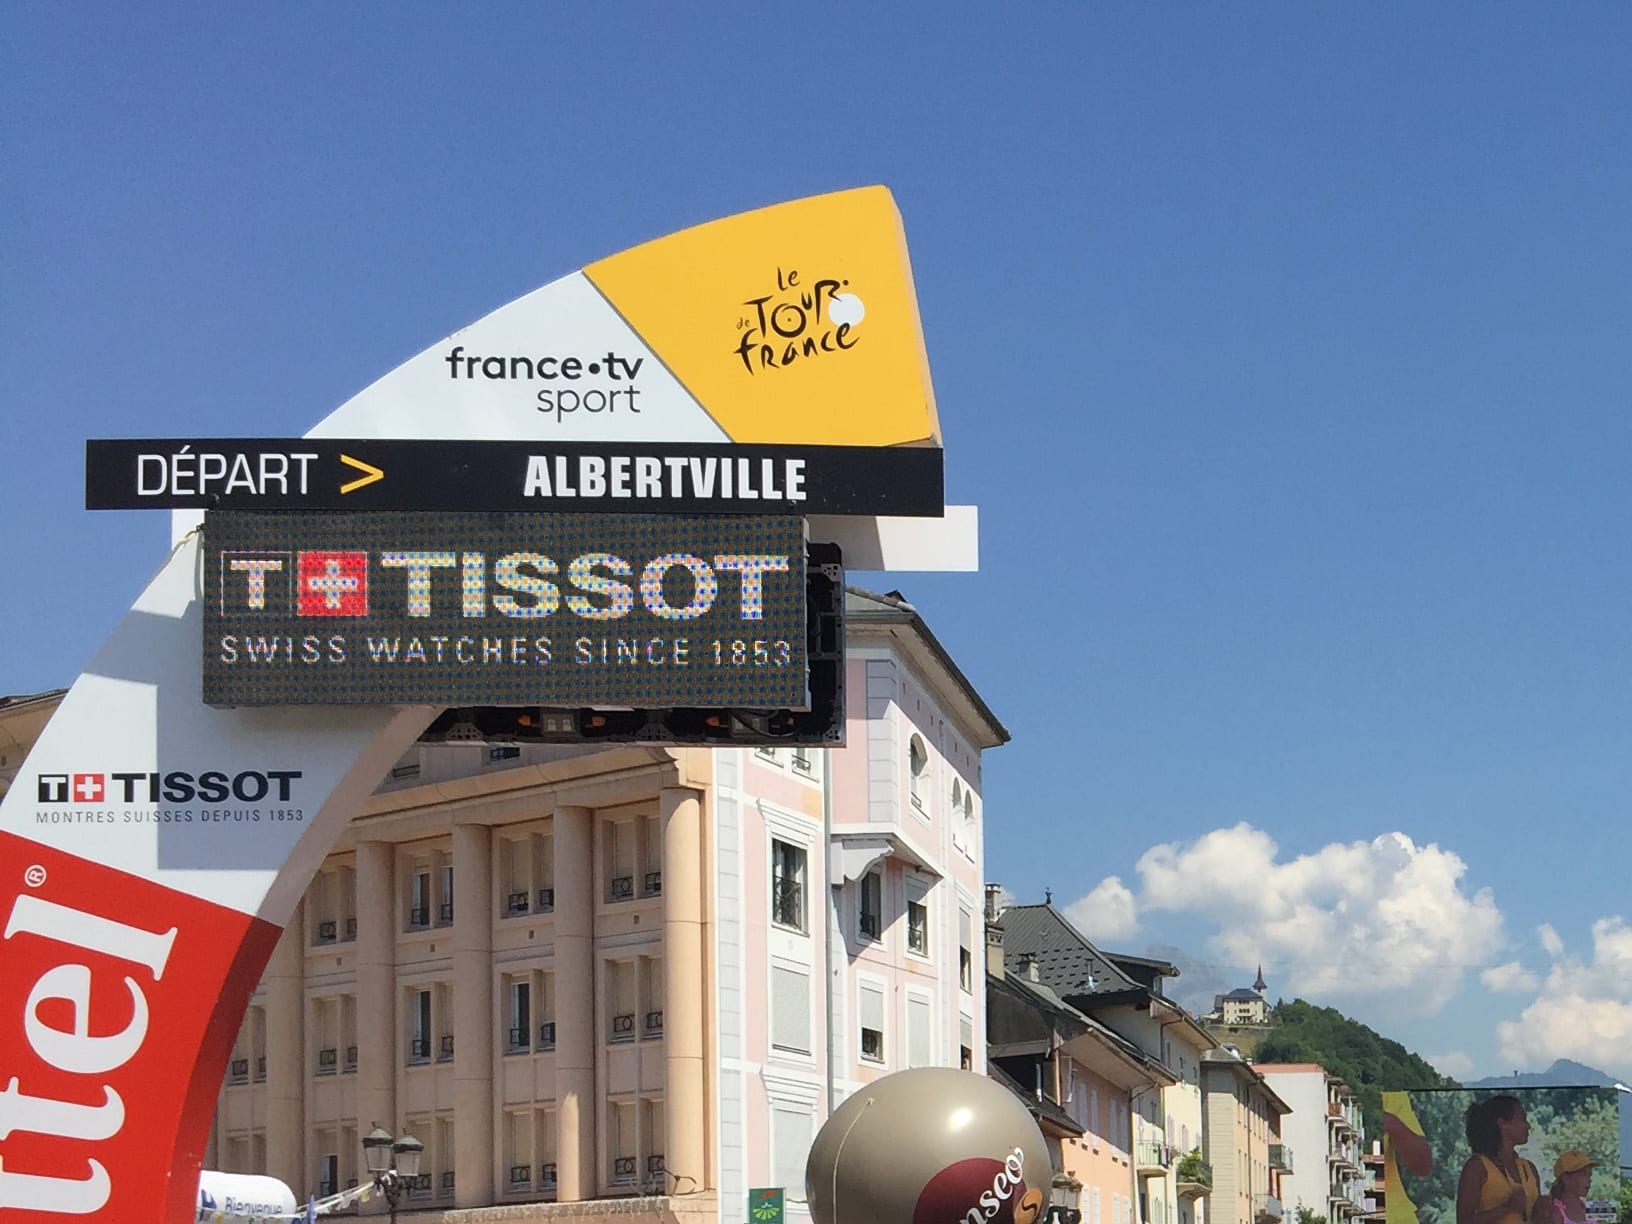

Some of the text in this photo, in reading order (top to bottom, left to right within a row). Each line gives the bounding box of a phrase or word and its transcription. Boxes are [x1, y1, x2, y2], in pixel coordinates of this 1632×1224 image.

[536, 384, 642, 423] sport
[135, 445, 807, 501] DÉPART ALBERTVILLE
[379, 551, 790, 621] TISSOT
[221, 634, 793, 668] SWISS WATCHES SINCE 1853
[111, 770, 303, 803] TISSOT
[36, 808, 304, 824] MONTRES SUISSES DEPUIS 1853
